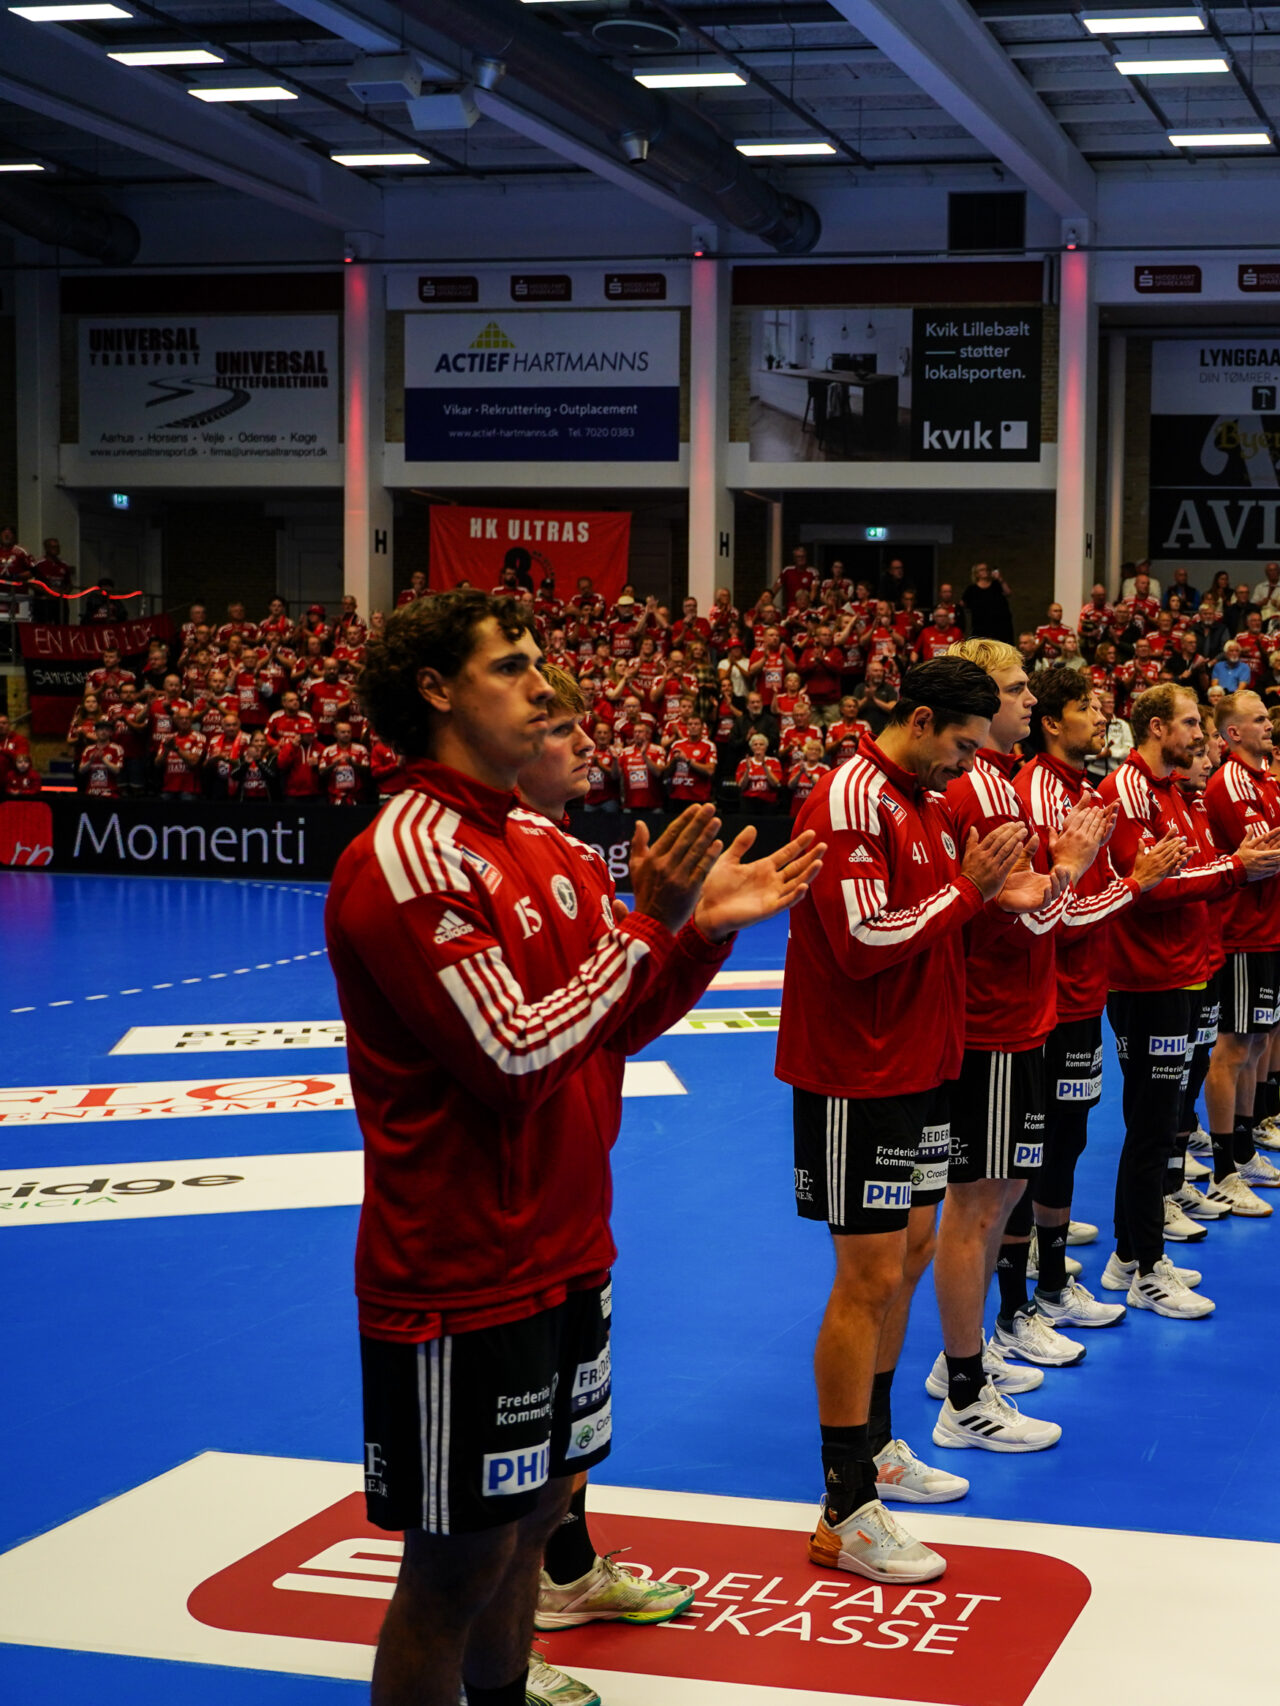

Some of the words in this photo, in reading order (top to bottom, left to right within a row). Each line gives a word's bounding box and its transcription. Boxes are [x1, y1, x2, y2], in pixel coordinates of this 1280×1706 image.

[89, 328, 199, 351] UNIVERSAL
[926, 322, 958, 337] Kvik
[963, 322, 1030, 337] Lillebælt
[90, 353, 199, 366] TRANSPORT
[215, 351, 328, 374] UNIVERSAL
[434, 352, 510, 373] ACTIEF
[513, 351, 649, 372] HARTMANNS
[960, 345, 1009, 358] støtter
[925, 366, 1026, 383] lokalsporten.
[1200, 372, 1220, 384] DIN
[1224, 372, 1271, 384] TØMRER
[443, 404, 472, 415] Vikar
[481, 404, 551, 418] Rekruttering
[560, 404, 638, 418] Outplacement
[101, 433, 134, 443] Aarhus
[148, 433, 188, 443] Horsens
[239, 433, 277, 443] Odense
[922, 420, 992, 449] kvik
[470, 517, 498, 540] HK
[508, 519, 590, 543] ULTRAS
[34, 627, 64, 655] EN
[73, 812, 305, 865] Momenti
[912, 841, 930, 865] 41
[513, 896, 543, 940] 15
[433, 923, 475, 945] adidas
[0, 1098, 346, 1122] ENDOMM
